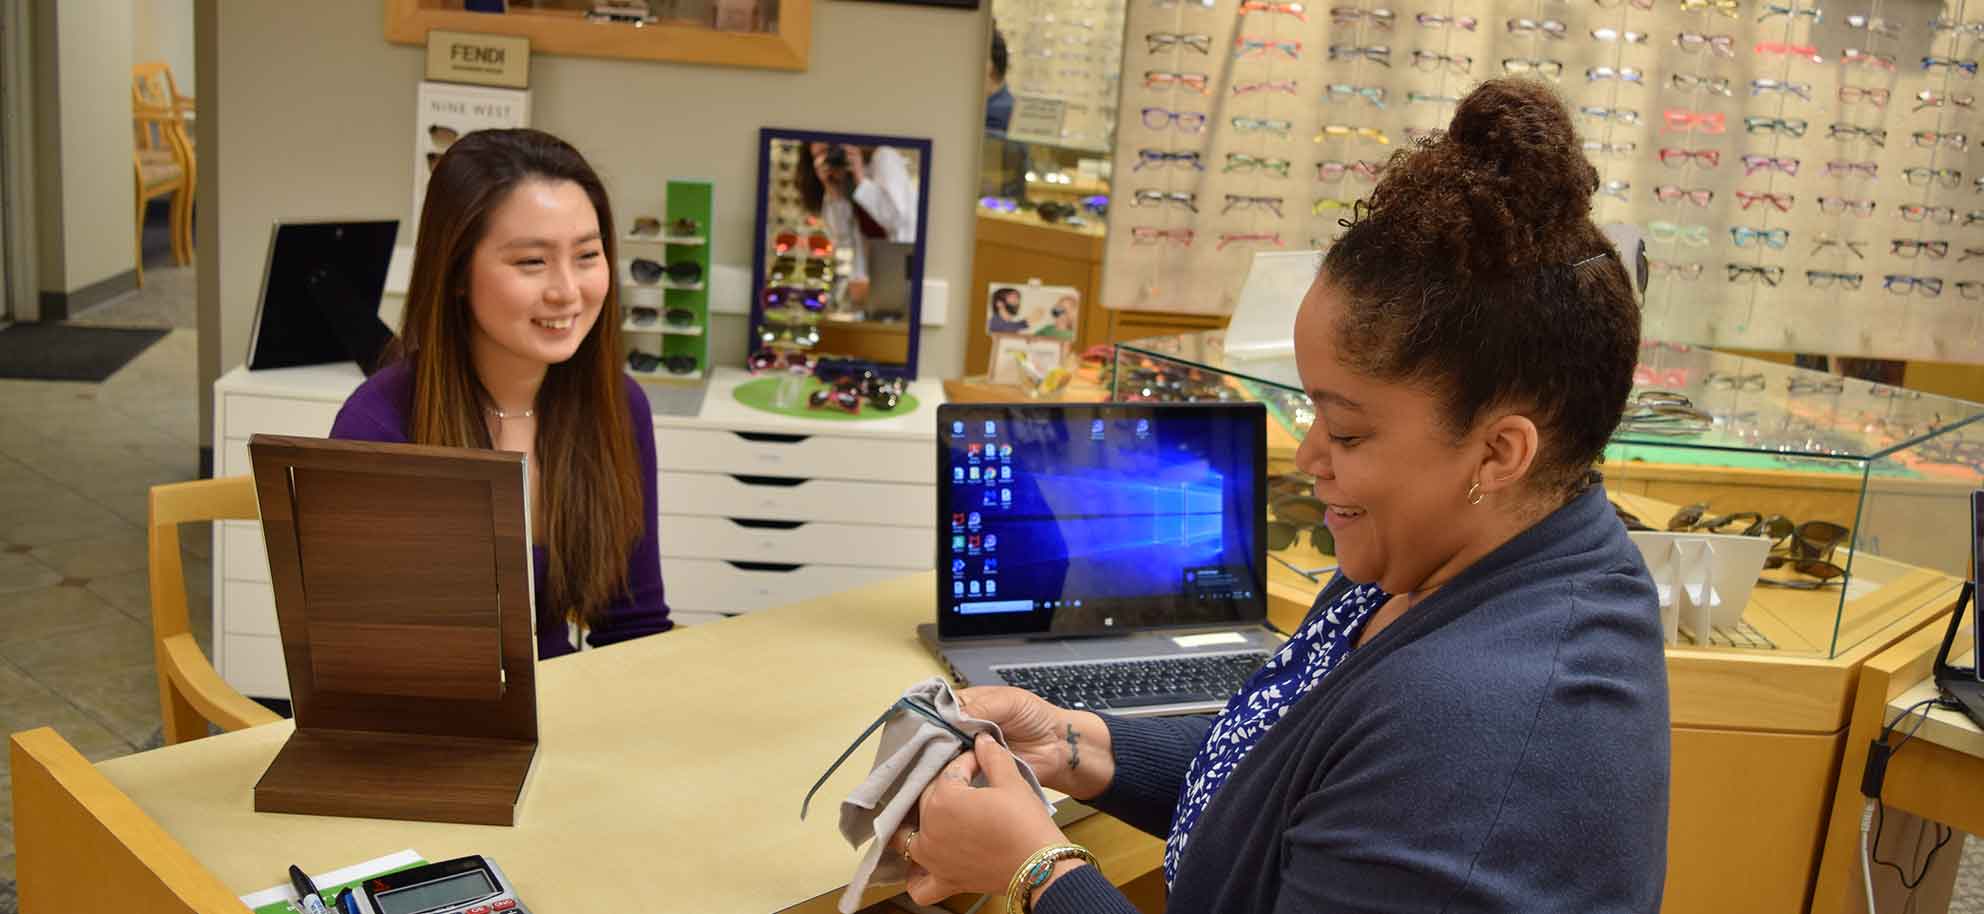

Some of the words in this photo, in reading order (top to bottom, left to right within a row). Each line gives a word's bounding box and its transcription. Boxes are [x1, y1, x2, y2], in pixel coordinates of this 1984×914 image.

[450, 43, 505, 64] FENDI
[431, 101, 465, 114] NINE
[474, 104, 512, 118] WEST
